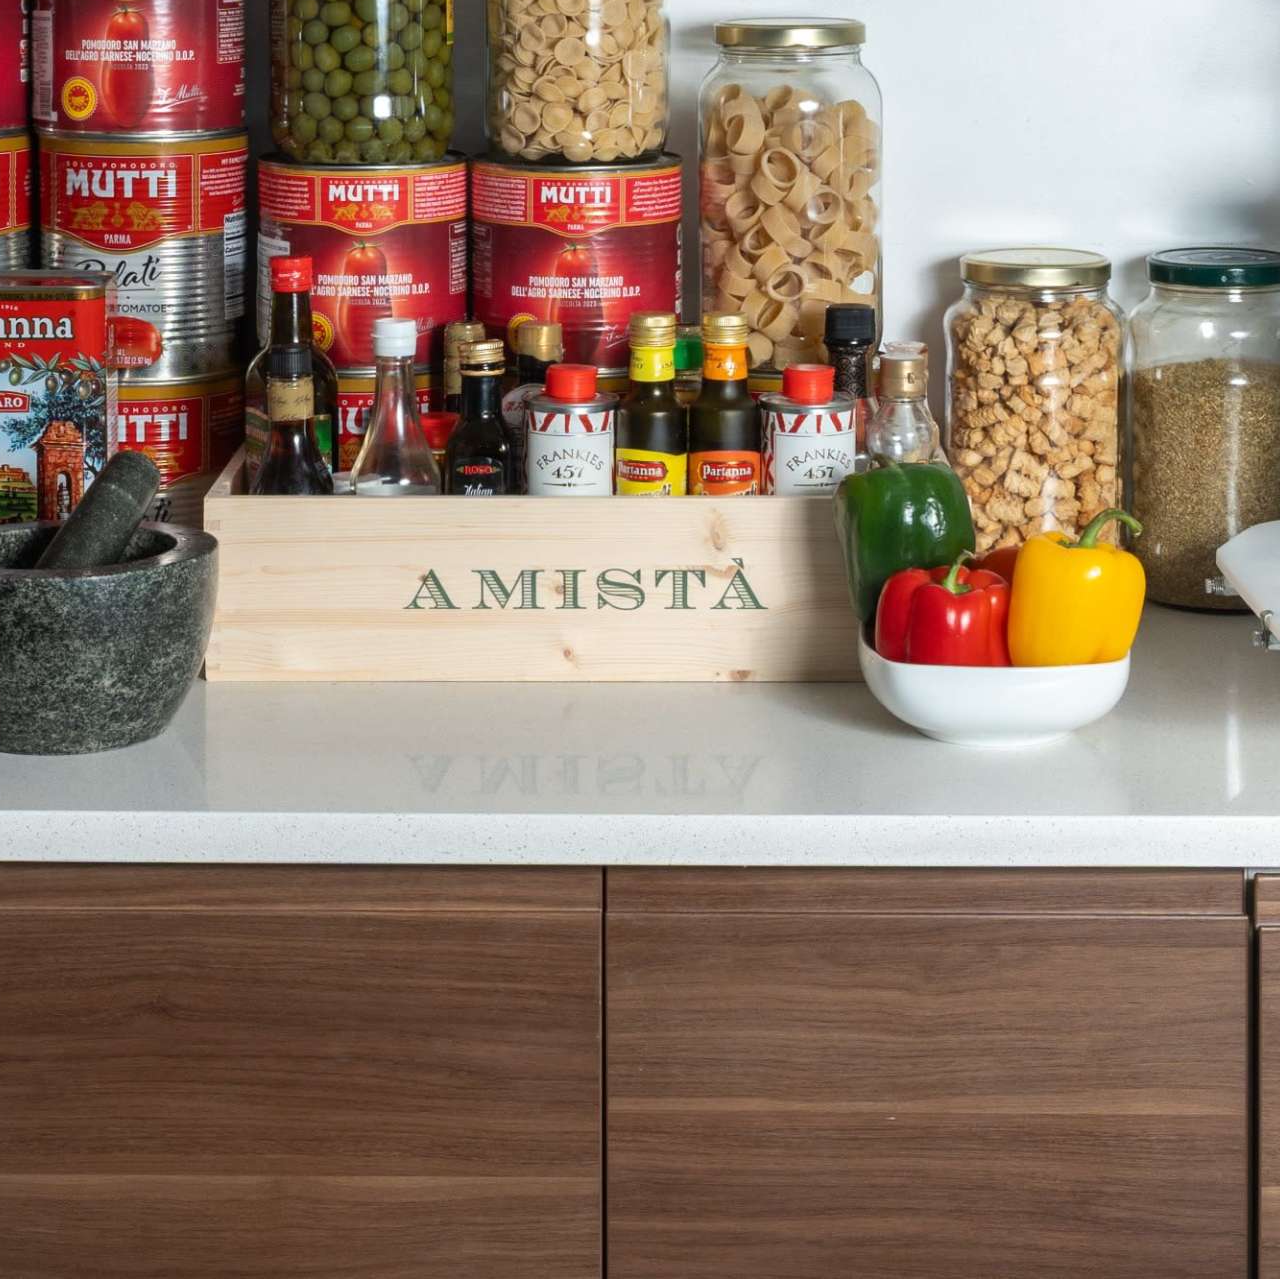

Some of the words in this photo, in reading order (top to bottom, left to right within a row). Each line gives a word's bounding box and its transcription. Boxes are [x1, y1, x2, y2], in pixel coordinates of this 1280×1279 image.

[81, 40, 121, 50] POMODORO
[123, 40, 139, 50] SAN
[141, 40, 176, 50] MARZANO
[66, 169, 176, 198] MUTTI
[328, 184, 400, 202] MUTTI
[540, 186, 611, 204] MUTTI
[104, 234, 131, 244] PARMA
[318, 275, 359, 285] POMODORO
[361, 275, 377, 285] SAN
[378, 274, 413, 285] MARZANO
[529, 277, 570, 287] POMODORO
[572, 276, 588, 287] SAN
[589, 276, 624, 287] MARZANO
[337, 285, 411, 297] SARNESE-NOCERINO
[548, 287, 621, 298] SARNESE-NOCERINO
[536, 448, 604, 471] FRANKIES
[786, 448, 852, 472] FRANKIES
[552, 465, 584, 480] 457
[703, 463, 753, 479] Partanna
[803, 465, 835, 480] 457
[403, 557, 769, 611] AMISTÀ
